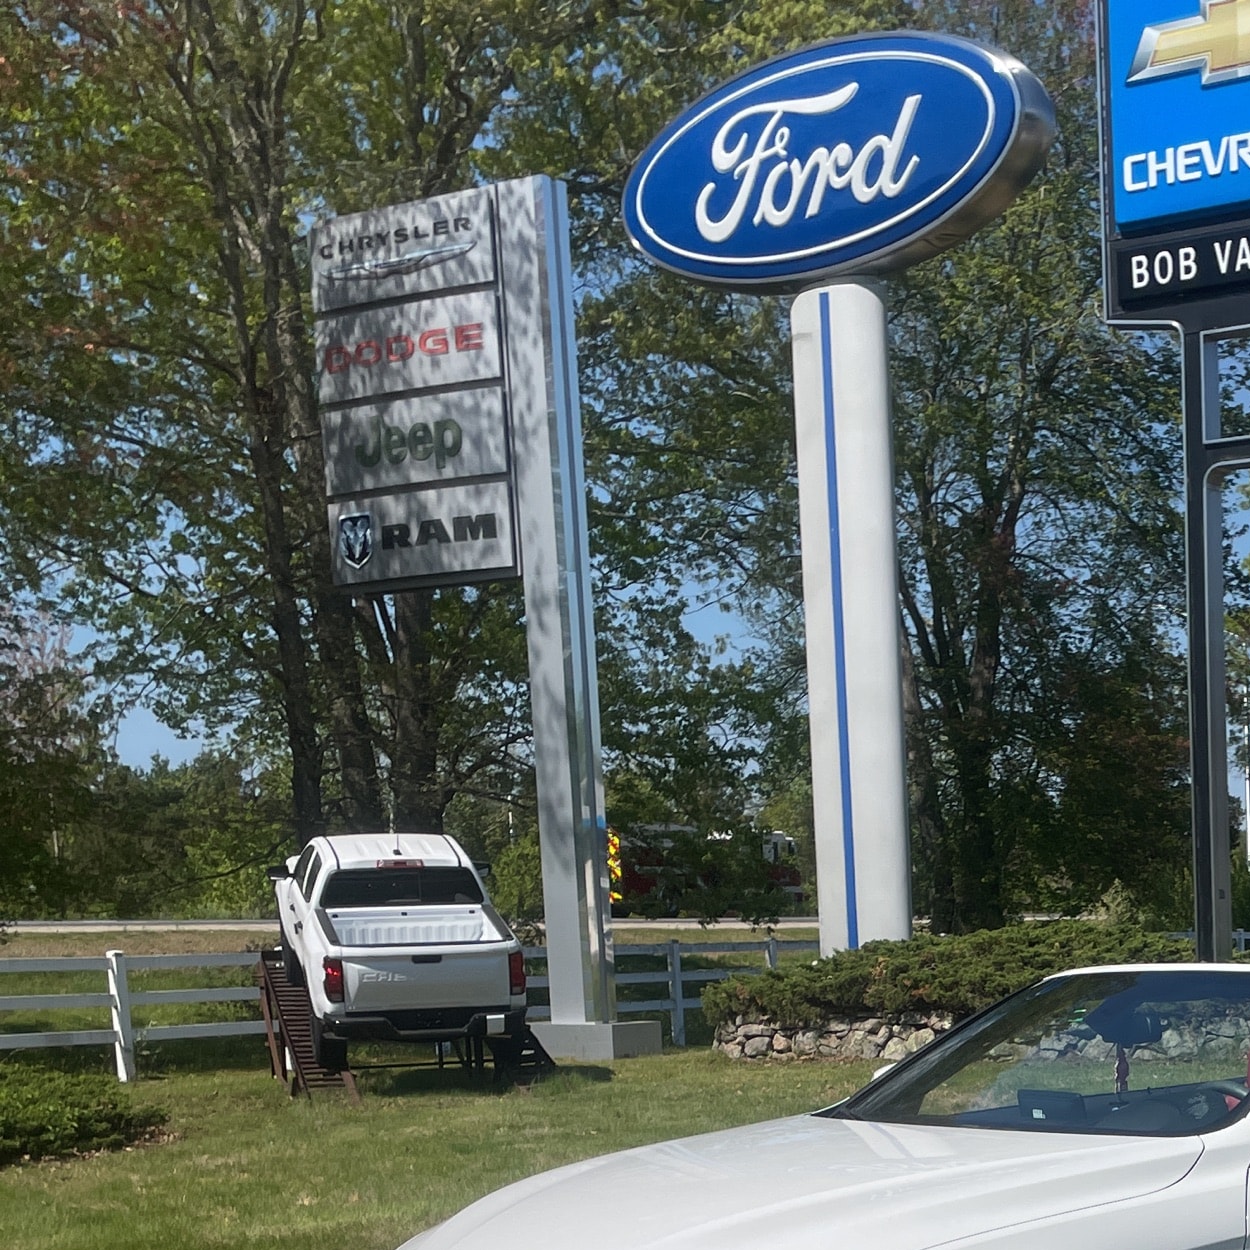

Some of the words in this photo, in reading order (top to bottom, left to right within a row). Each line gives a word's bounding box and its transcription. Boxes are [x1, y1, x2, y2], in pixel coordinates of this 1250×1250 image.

[696, 82, 922, 242] Ford
[320, 216, 471, 260] CHRYSLER
[1131, 246, 1197, 289] BOB
[326, 322, 484, 374] DODGE
[356, 414, 462, 469] Jeep
[382, 513, 497, 550] RAM
